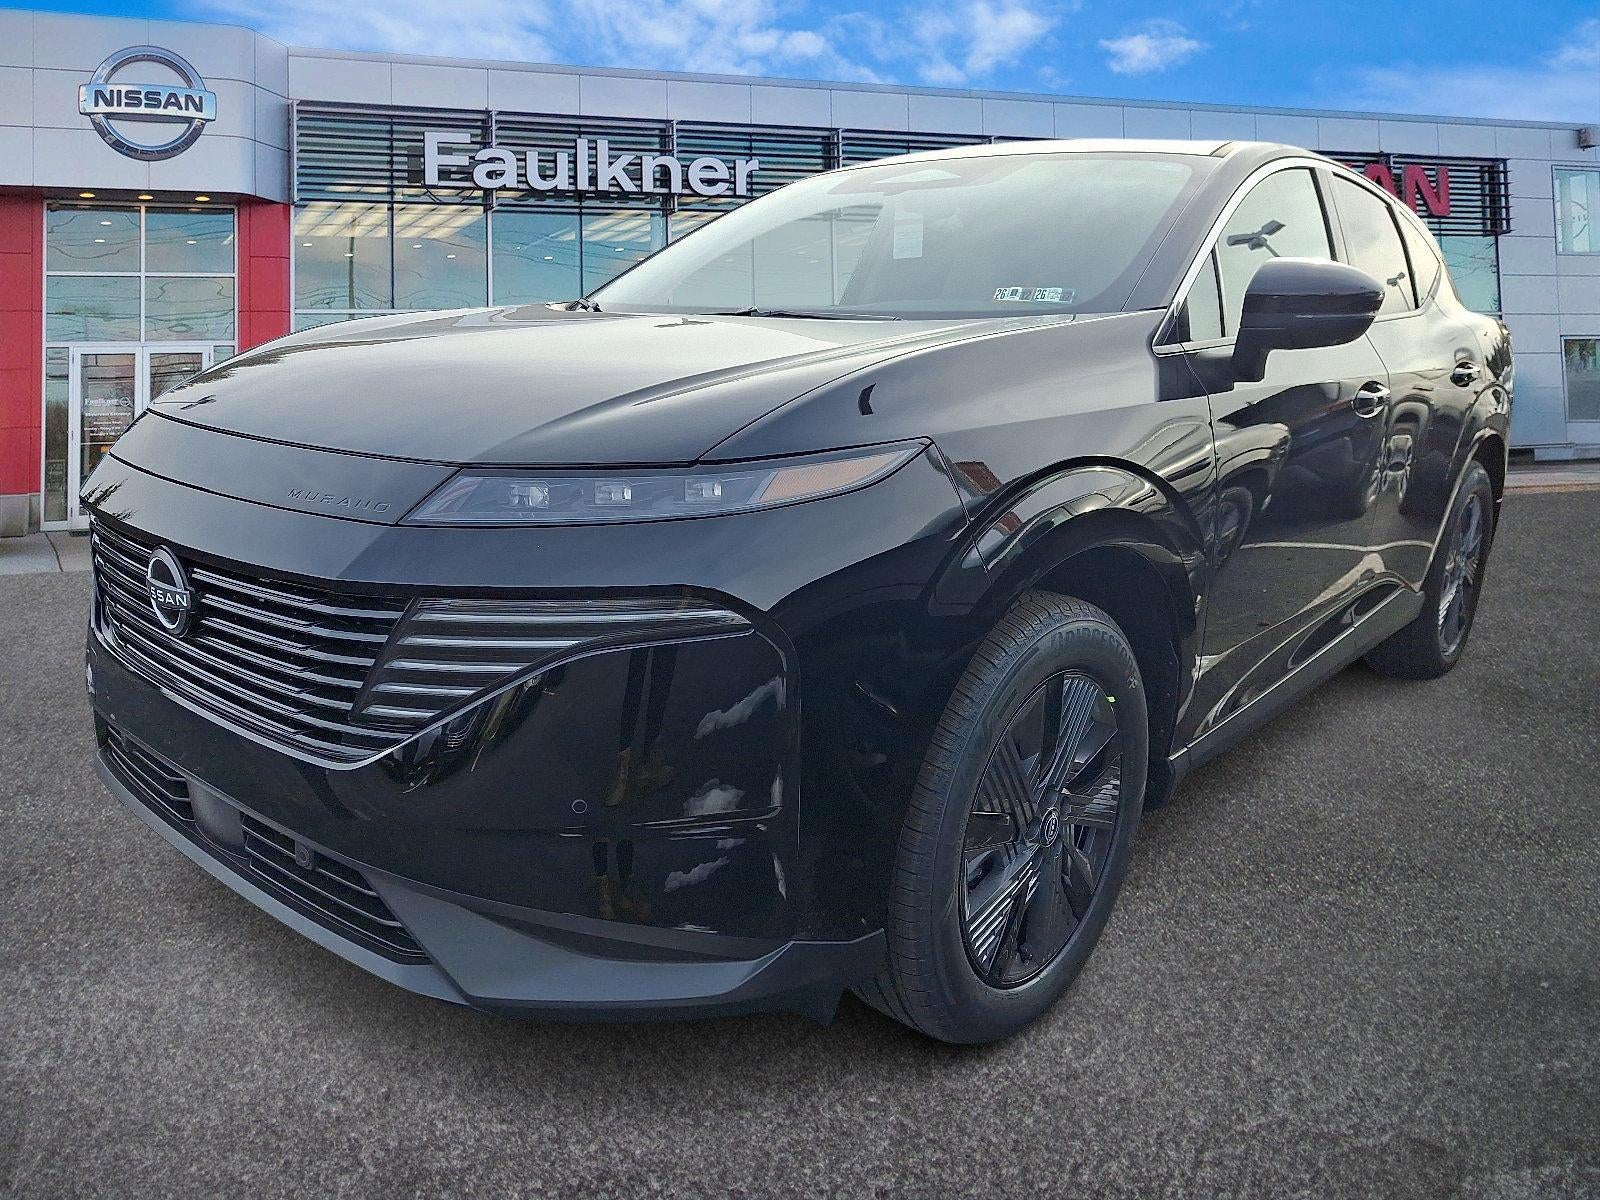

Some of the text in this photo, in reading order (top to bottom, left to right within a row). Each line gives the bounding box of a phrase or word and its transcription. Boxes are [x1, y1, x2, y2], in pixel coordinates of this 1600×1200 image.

[93, 88, 204, 113] NISSAN
[423, 131, 760, 196] Faulkner
[1343, 161, 1451, 217] AN
[995, 287, 1008, 300] 26
[1035, 288, 1048, 300] 26
[287, 488, 392, 513] MURANO
